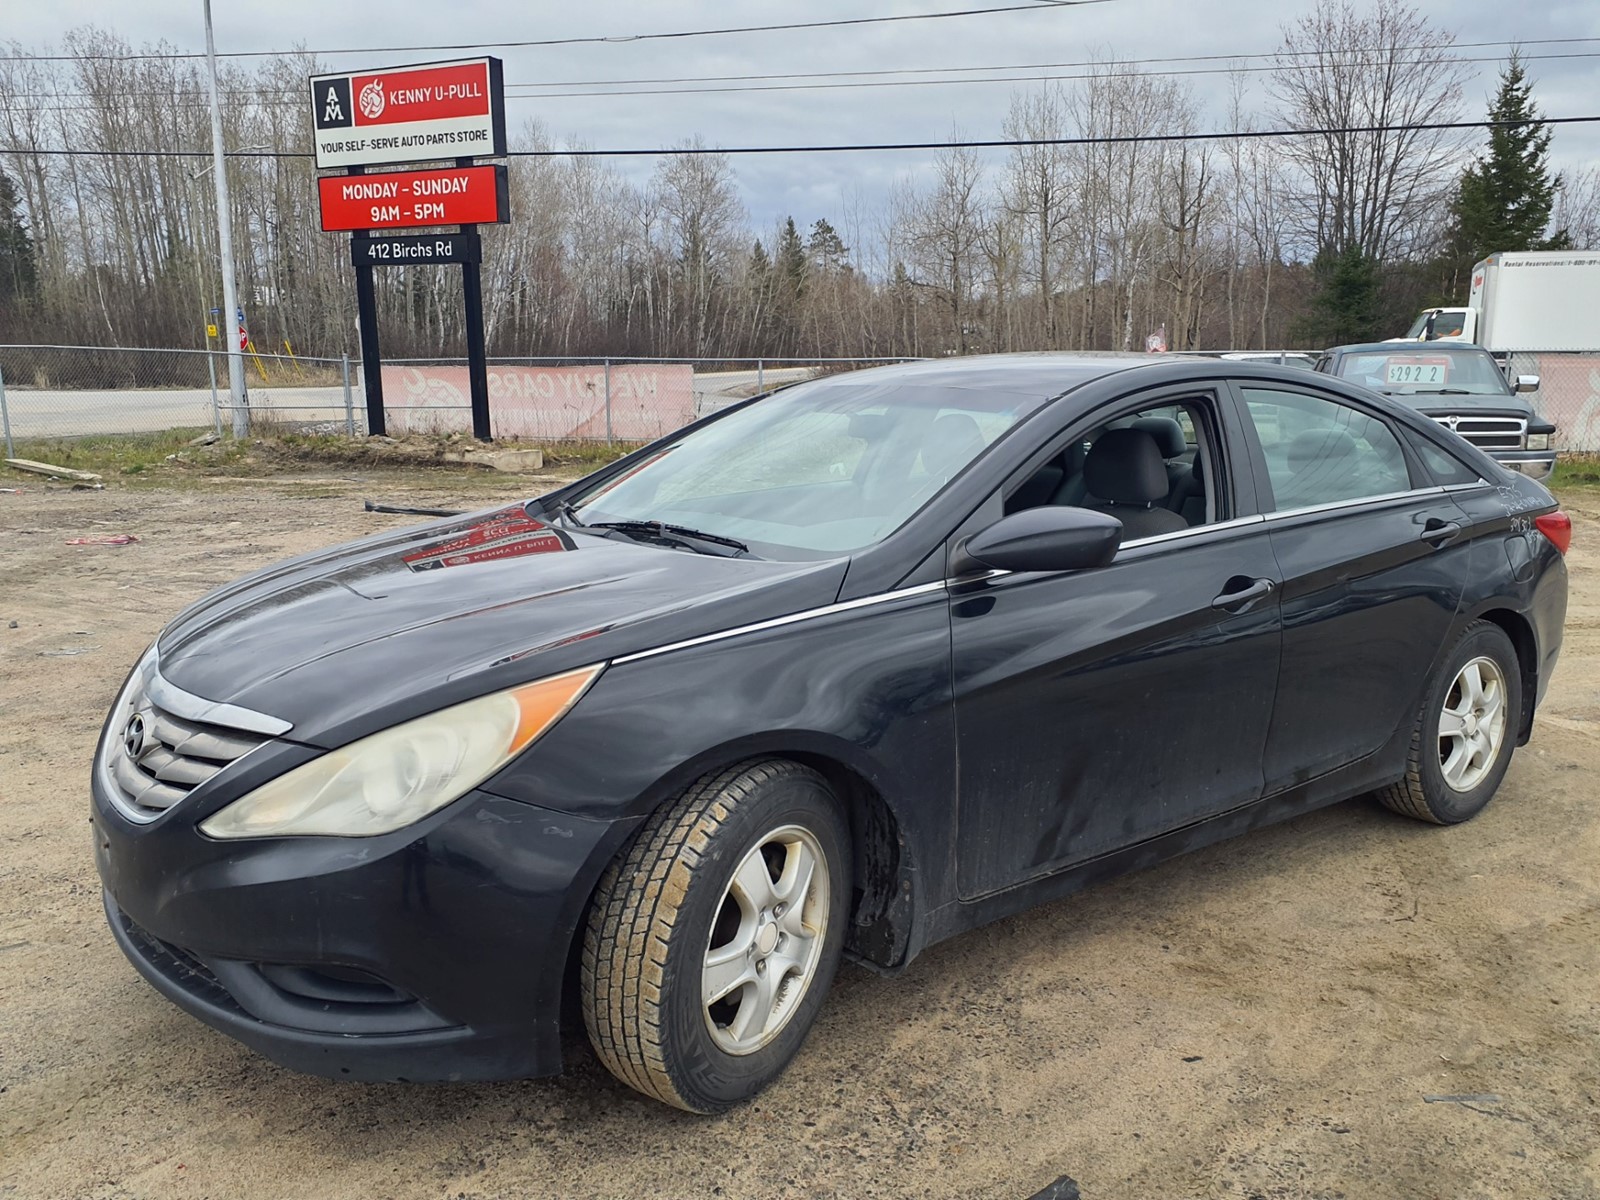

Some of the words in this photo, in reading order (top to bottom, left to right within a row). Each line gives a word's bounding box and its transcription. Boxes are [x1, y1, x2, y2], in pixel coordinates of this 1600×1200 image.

[389, 87, 432, 105] KENNY
[434, 82, 482, 101] U-PULL
[320, 142, 344, 154] YOUR
[345, 137, 400, 152] SELF-SERVE
[401, 134, 425, 147] AUTO
[426, 132, 456, 145] PARTS
[457, 129, 488, 142] STORE
[342, 181, 399, 200] MONDAY
[412, 176, 469, 196] SUNDAY
[370, 205, 400, 222] 9AM
[414, 202, 445, 220] 5PM
[368, 243, 390, 259] 412
[392, 242, 433, 258] Birchs
[435, 241, 453, 256] Rd
